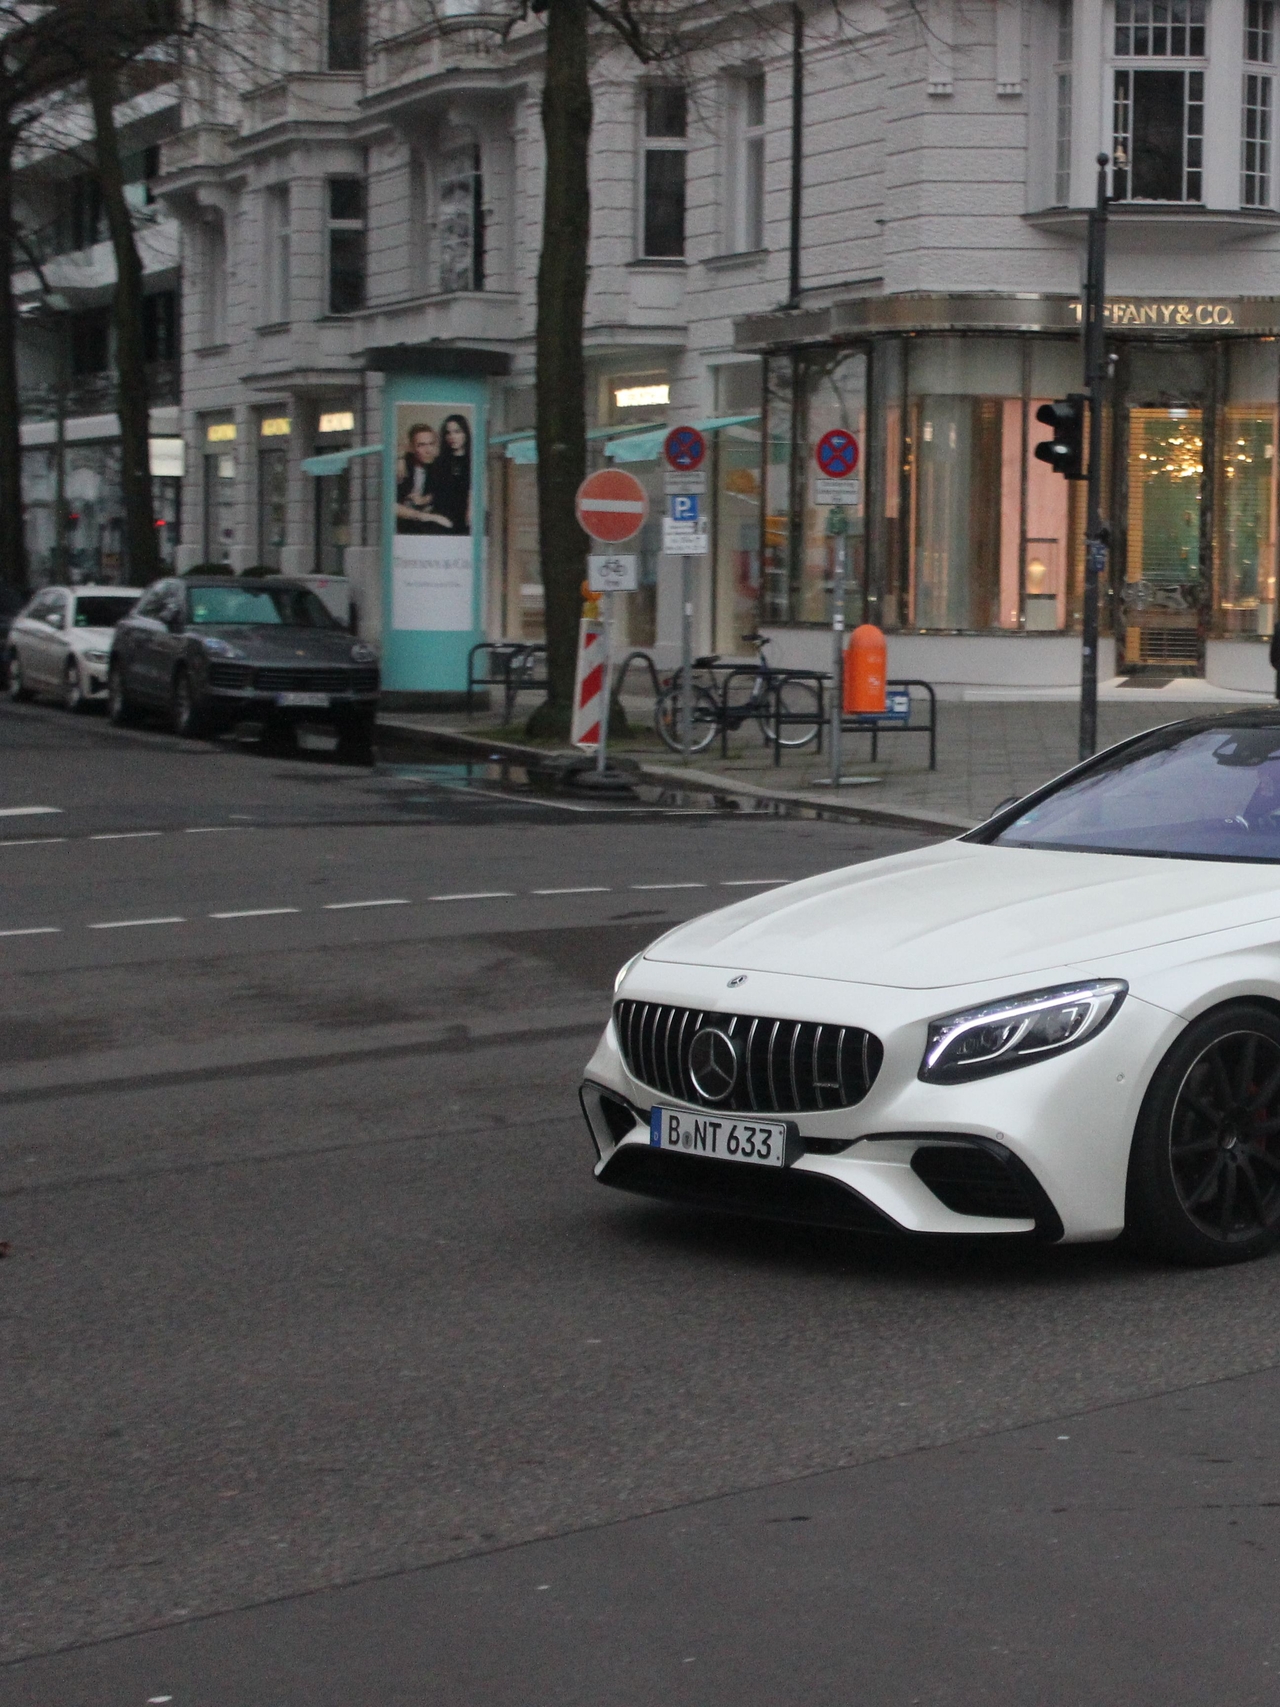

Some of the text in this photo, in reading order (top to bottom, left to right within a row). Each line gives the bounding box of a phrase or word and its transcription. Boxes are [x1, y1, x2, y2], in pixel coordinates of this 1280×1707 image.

[668, 1115, 681, 1146] B
[694, 1119, 722, 1153] NT
[726, 1124, 773, 1160] 633
